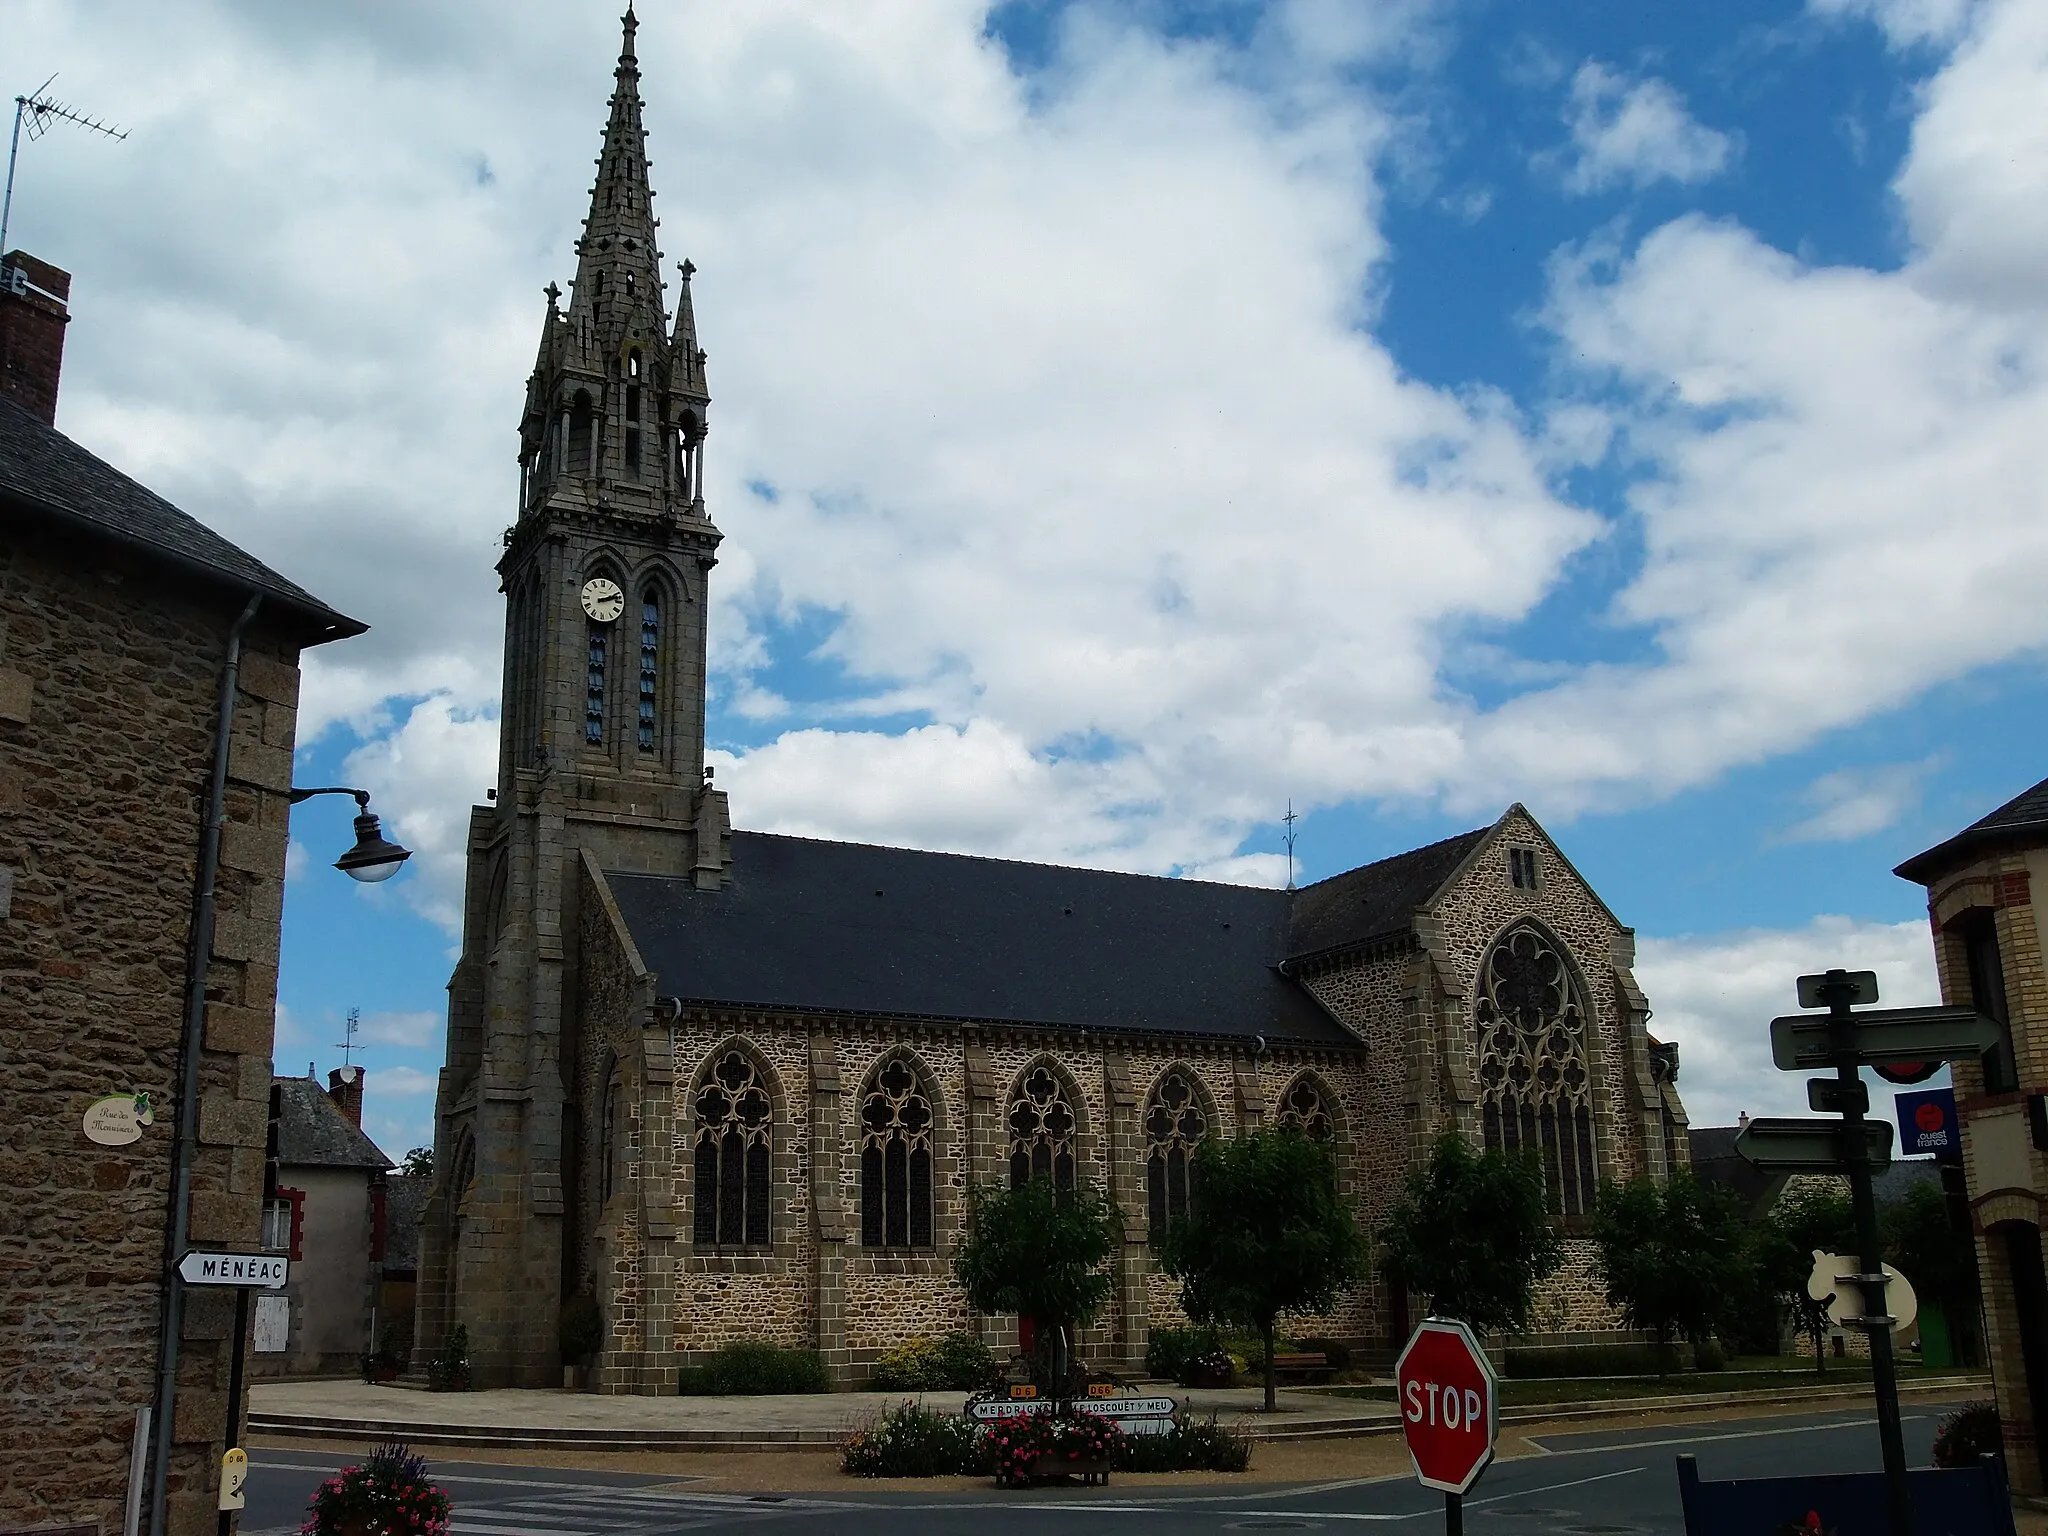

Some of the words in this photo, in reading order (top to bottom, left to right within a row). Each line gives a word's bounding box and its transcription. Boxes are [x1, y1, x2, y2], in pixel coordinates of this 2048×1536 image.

[100, 1107, 117, 1118] Rue
[118, 1110, 129, 1120] des
[1919, 1130, 1947, 1140] ouest
[1917, 1138, 1948, 1147] france
[202, 1258, 282, 1279] MÉNÉAC
[1015, 1388, 1022, 1396] D
[1025, 1387, 1031, 1396] 6
[1090, 1385, 1111, 1395] D66
[1147, 1401, 1168, 1411] MEU
[1406, 1380, 1481, 1433] STOP
[232, 1474, 238, 1486] 3
